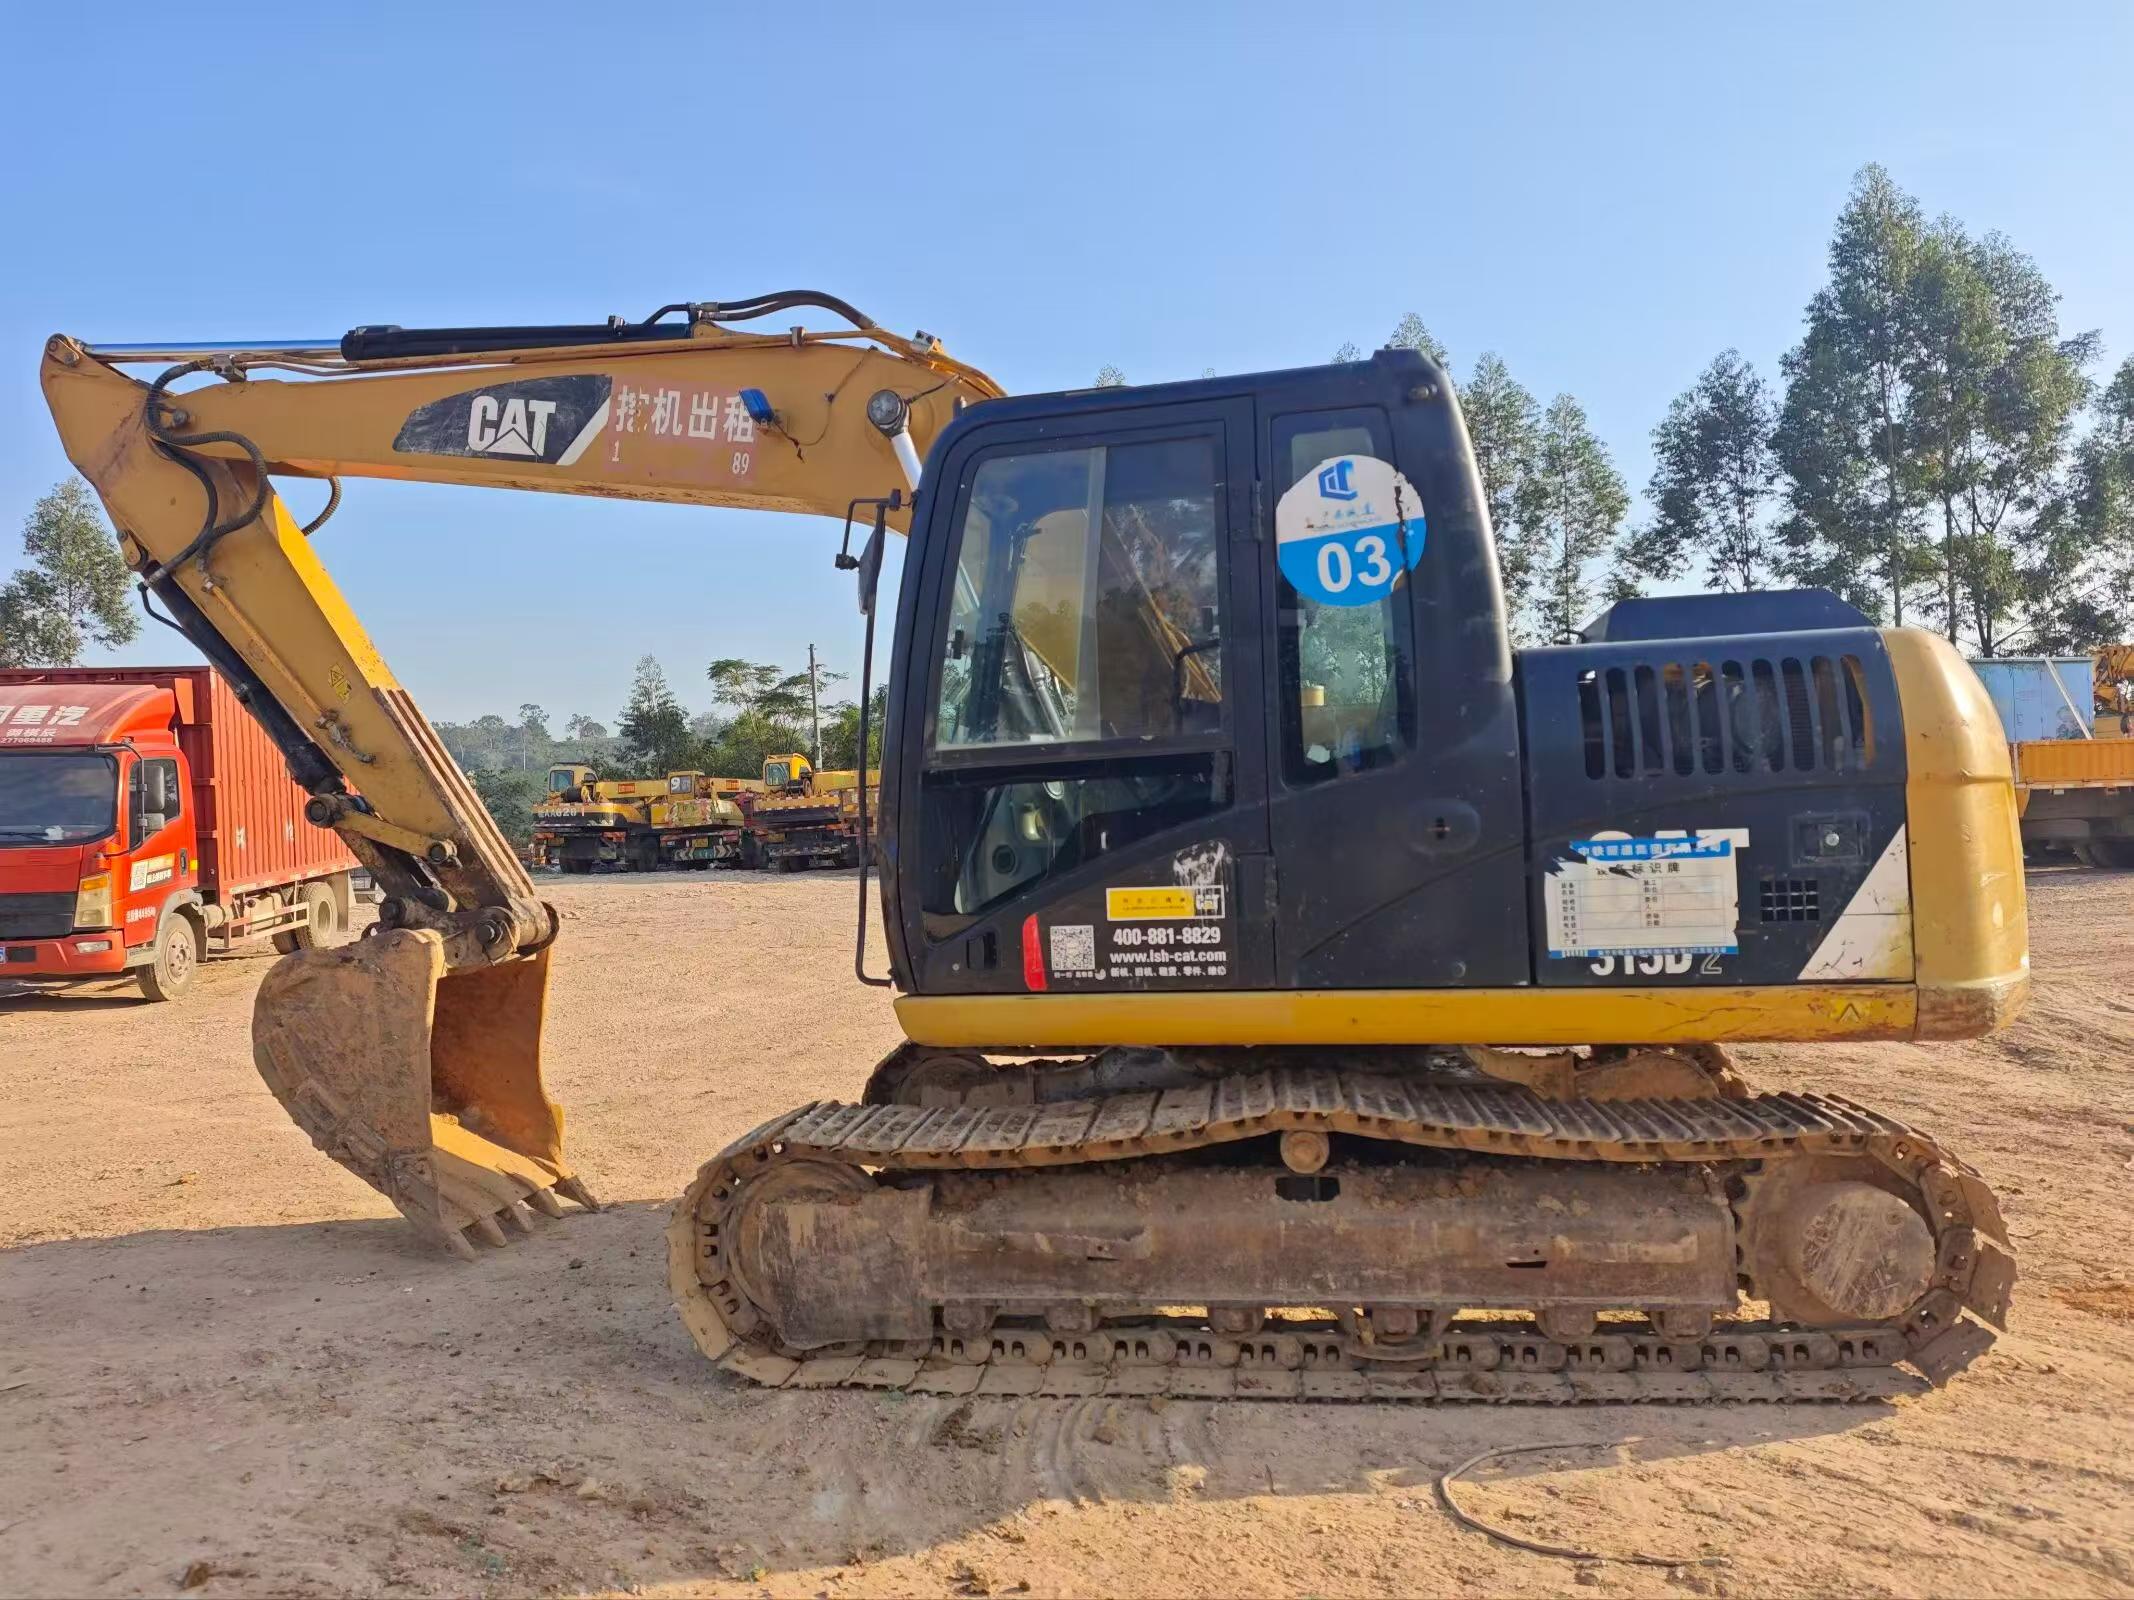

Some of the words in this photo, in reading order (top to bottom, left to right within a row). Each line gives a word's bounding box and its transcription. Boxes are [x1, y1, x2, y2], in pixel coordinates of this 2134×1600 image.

[468, 395, 556, 456] CAT
[732, 451, 750, 475] 89
[1317, 535, 1391, 593] 03
[1113, 927, 1221, 945] 400-881-8829
[1110, 949, 1227, 964] www.lsh-cat.com
